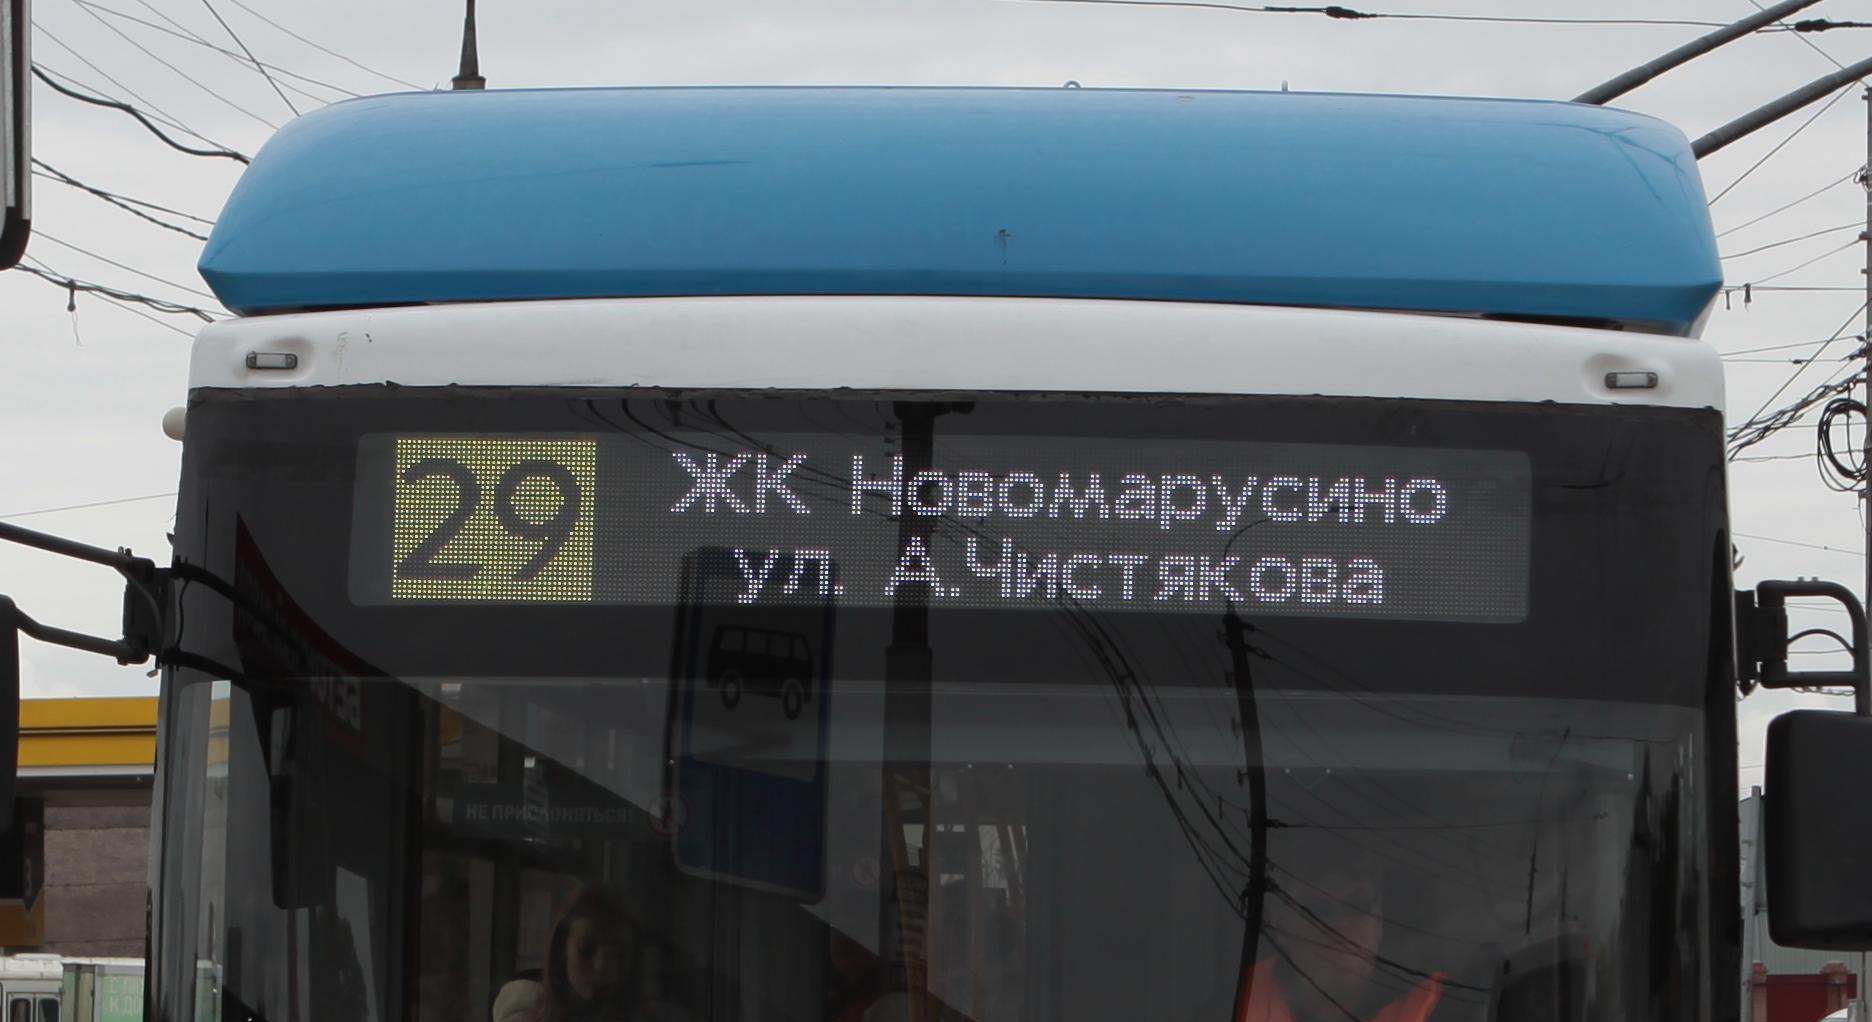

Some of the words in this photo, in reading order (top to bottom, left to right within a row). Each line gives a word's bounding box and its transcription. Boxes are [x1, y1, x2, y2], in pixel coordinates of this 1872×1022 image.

[396, 456, 584, 583] 29
[669, 452, 811, 516] ЖК
[848, 453, 1449, 531] Новомарусино
[733, 547, 845, 605] ул.
[883, 535, 1388, 606] А.Чистякова
[465, 803, 488, 821] НЕ
